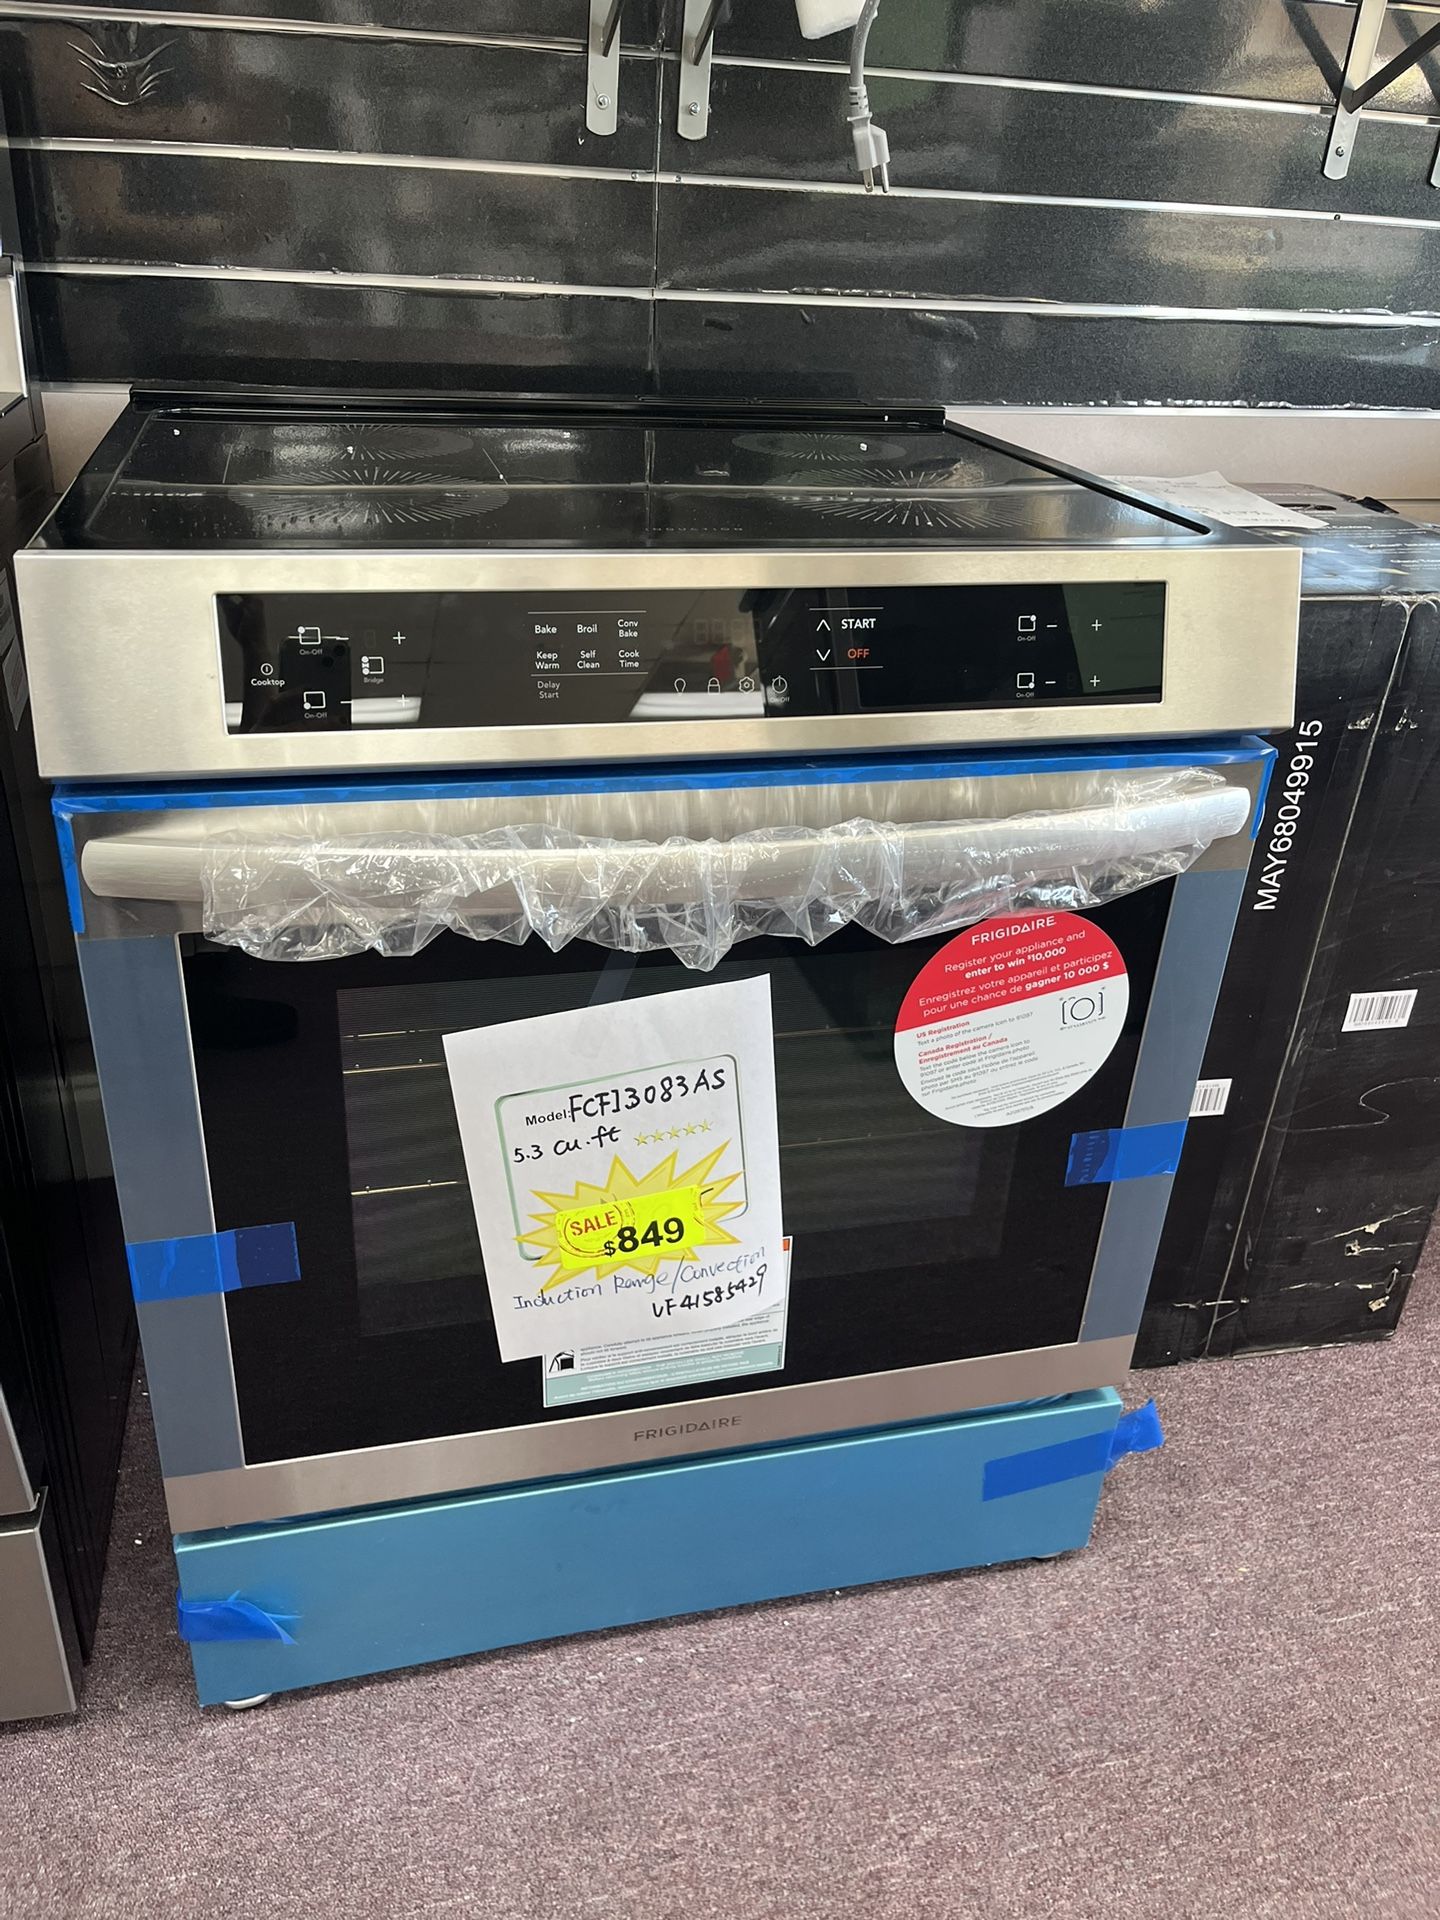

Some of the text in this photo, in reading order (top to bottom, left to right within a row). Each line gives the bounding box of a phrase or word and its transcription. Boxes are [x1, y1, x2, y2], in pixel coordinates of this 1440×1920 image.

[577, 624, 597, 633] Broil
[618, 619, 638, 628] Conv
[841, 618, 876, 629] START
[535, 625, 557, 634] Bake
[619, 629, 638, 638] Bake
[536, 651, 558, 662] Keep
[580, 650, 596, 659] Self
[619, 650, 639, 658] Cook
[848, 649, 870, 659] OFF
[535, 661, 560, 670] Warm
[577, 660, 600, 669] Clean
[619, 660, 639, 668] Time
[251, 678, 285, 687] Cooktop
[537, 680, 560, 690] Delay
[539, 690, 559, 699] Start
[1253, 718, 1323, 910] MAY68049915
[972, 916, 1056, 945] FRIGIDAIRE
[945, 931, 1086, 973] Register your appliance and
[965, 946, 1066, 979] enter to win $10,000
[919, 951, 1112, 1007] Enregistrez votre appareil et participez
[923, 961, 1109, 1017] pour une chance de gagner 10 000 $
[928, 1020, 969, 1036] Registration
[936, 1032, 952, 1042] photo
[918, 1045, 943, 1057] Canada
[945, 1034, 986, 1050] Registration
[918, 1046, 970, 1064] Enregistrement
[982, 1036, 1007, 1047] Canada
[525, 1109, 571, 1126] Model:
[514, 1145, 543, 1163] 5.3
[570, 1210, 619, 1236] SALE
[603, 1217, 685, 1257] $849
[514, 1284, 602, 1310] Induction
[633, 1415, 743, 1442] FRIGIDAIRE
